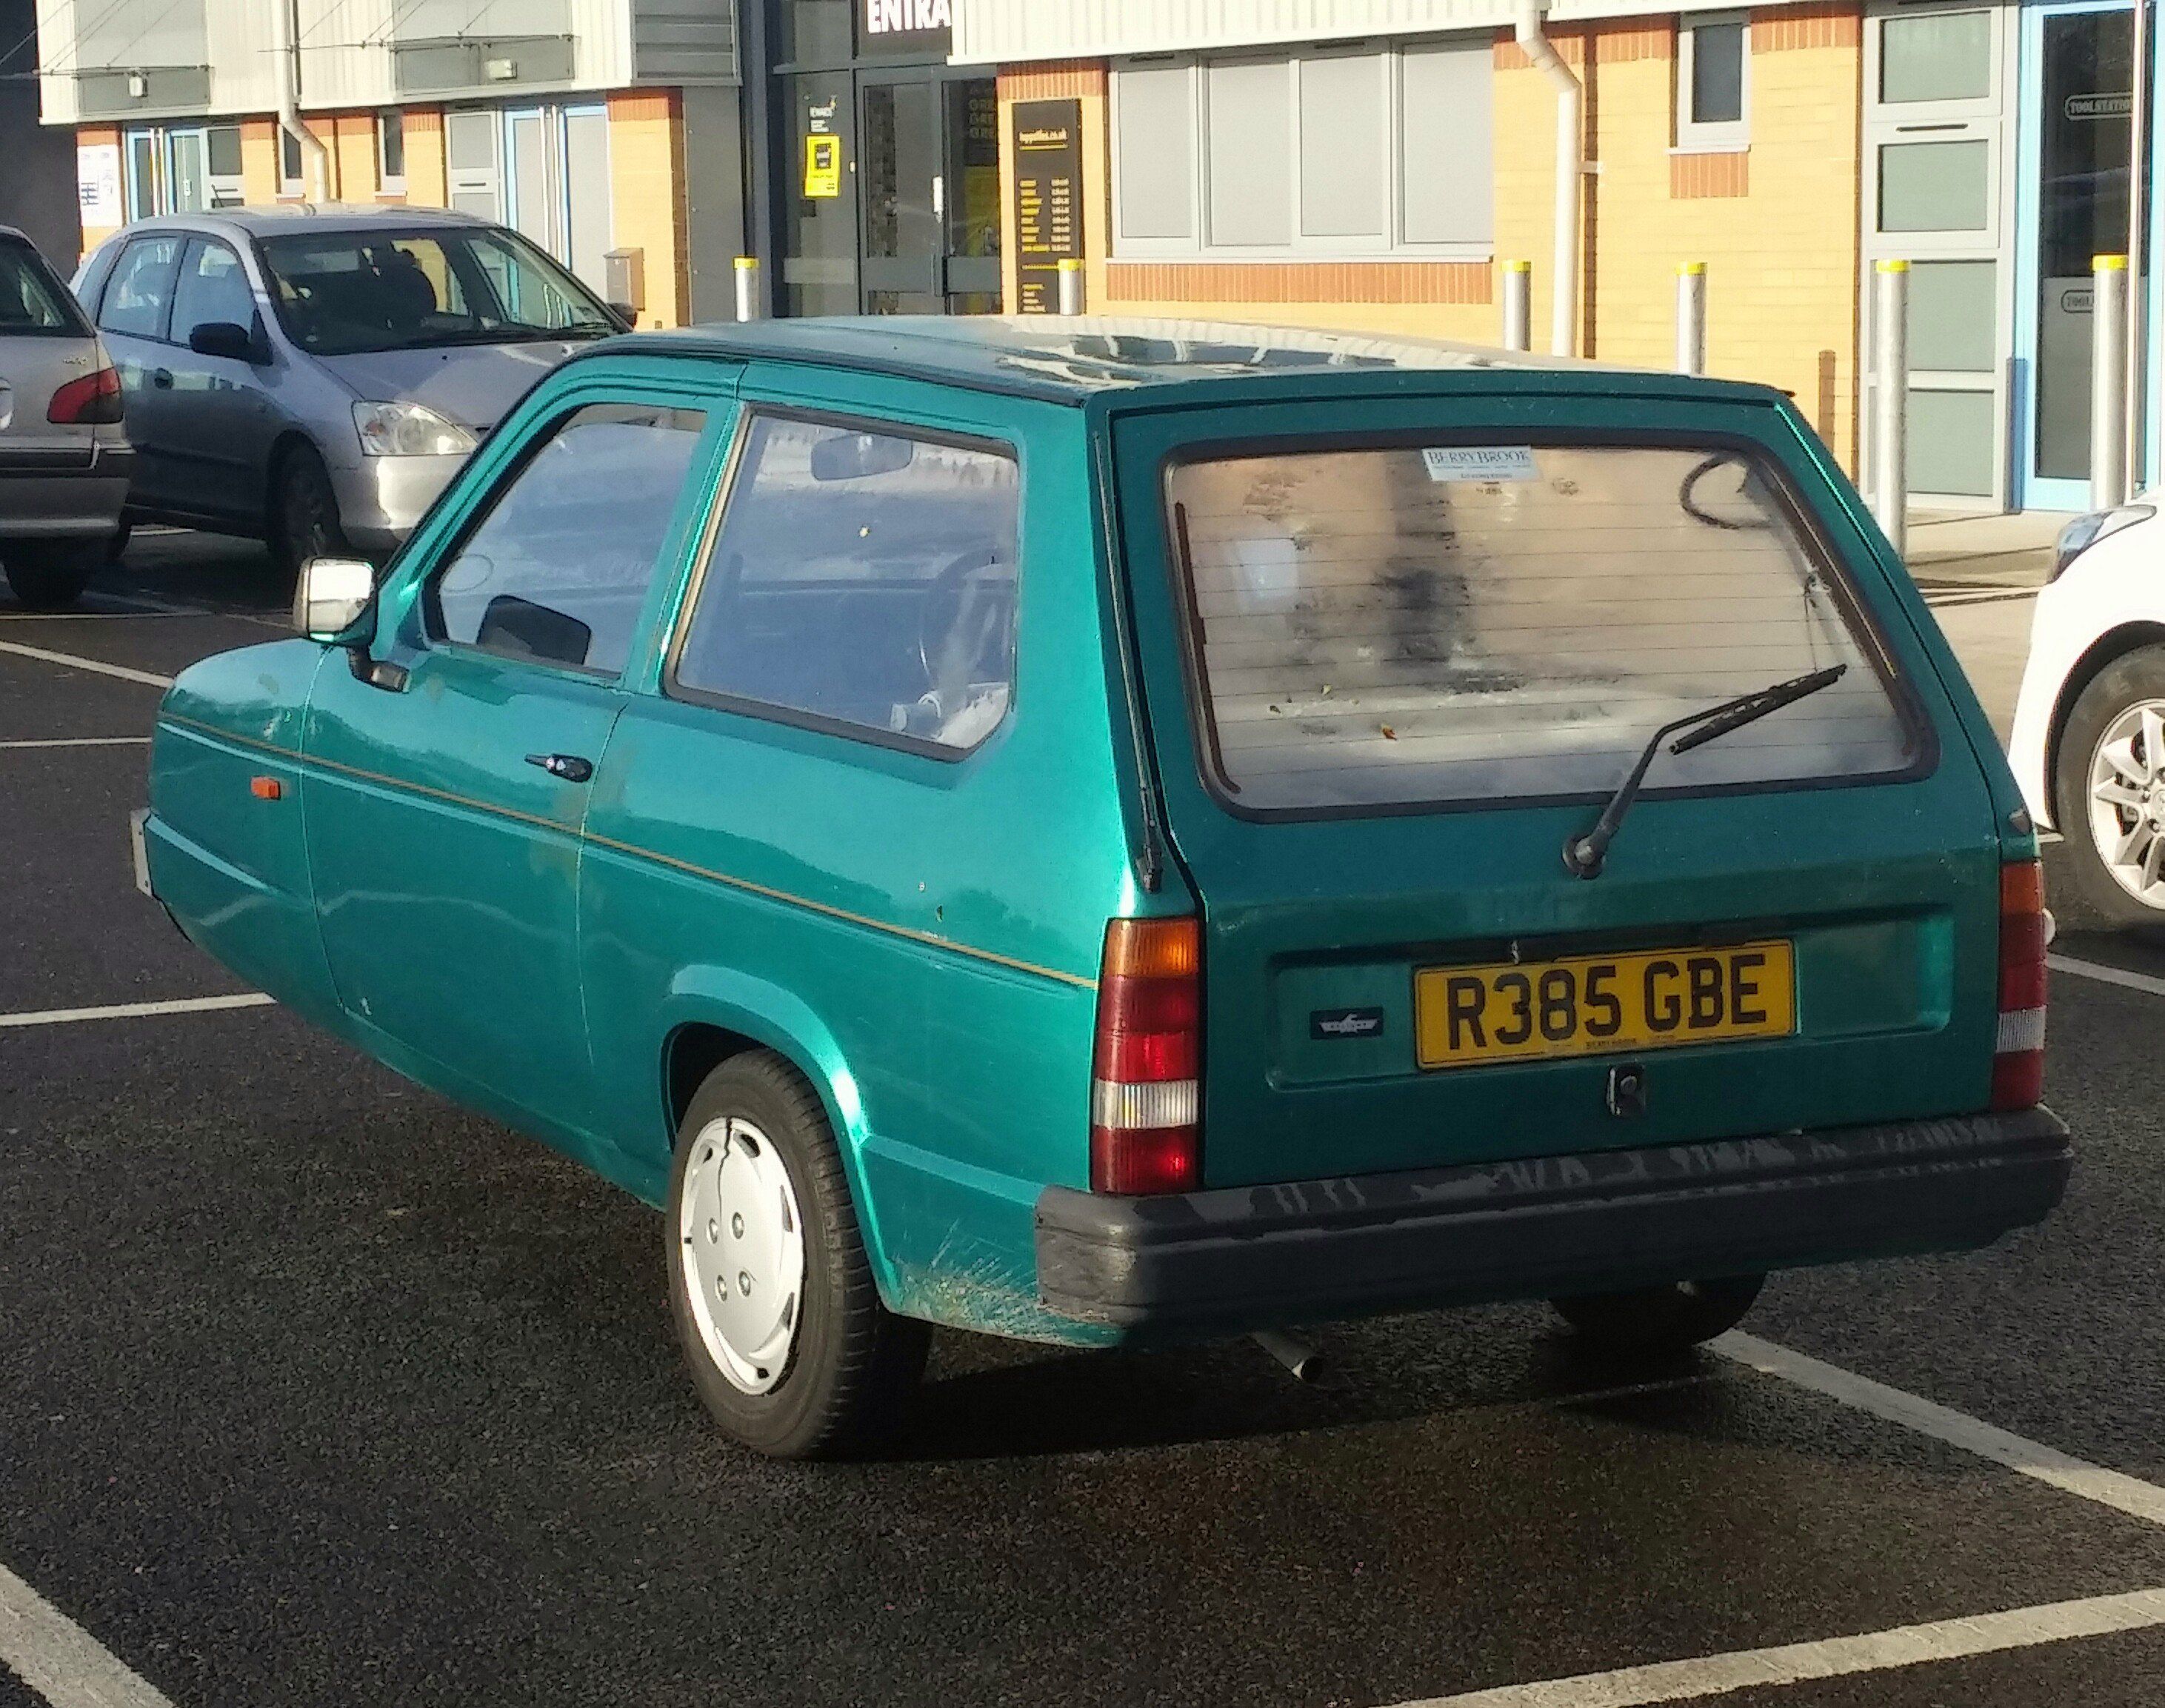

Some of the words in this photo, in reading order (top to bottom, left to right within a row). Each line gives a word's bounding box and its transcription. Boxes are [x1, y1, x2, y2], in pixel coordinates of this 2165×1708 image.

[2069, 99, 2132, 114] TOOLSTATIO
[1427, 450, 1529, 464] BERRYBROOK
[1446, 965, 1622, 1050] R385
[1644, 954, 1767, 1033] GBE
